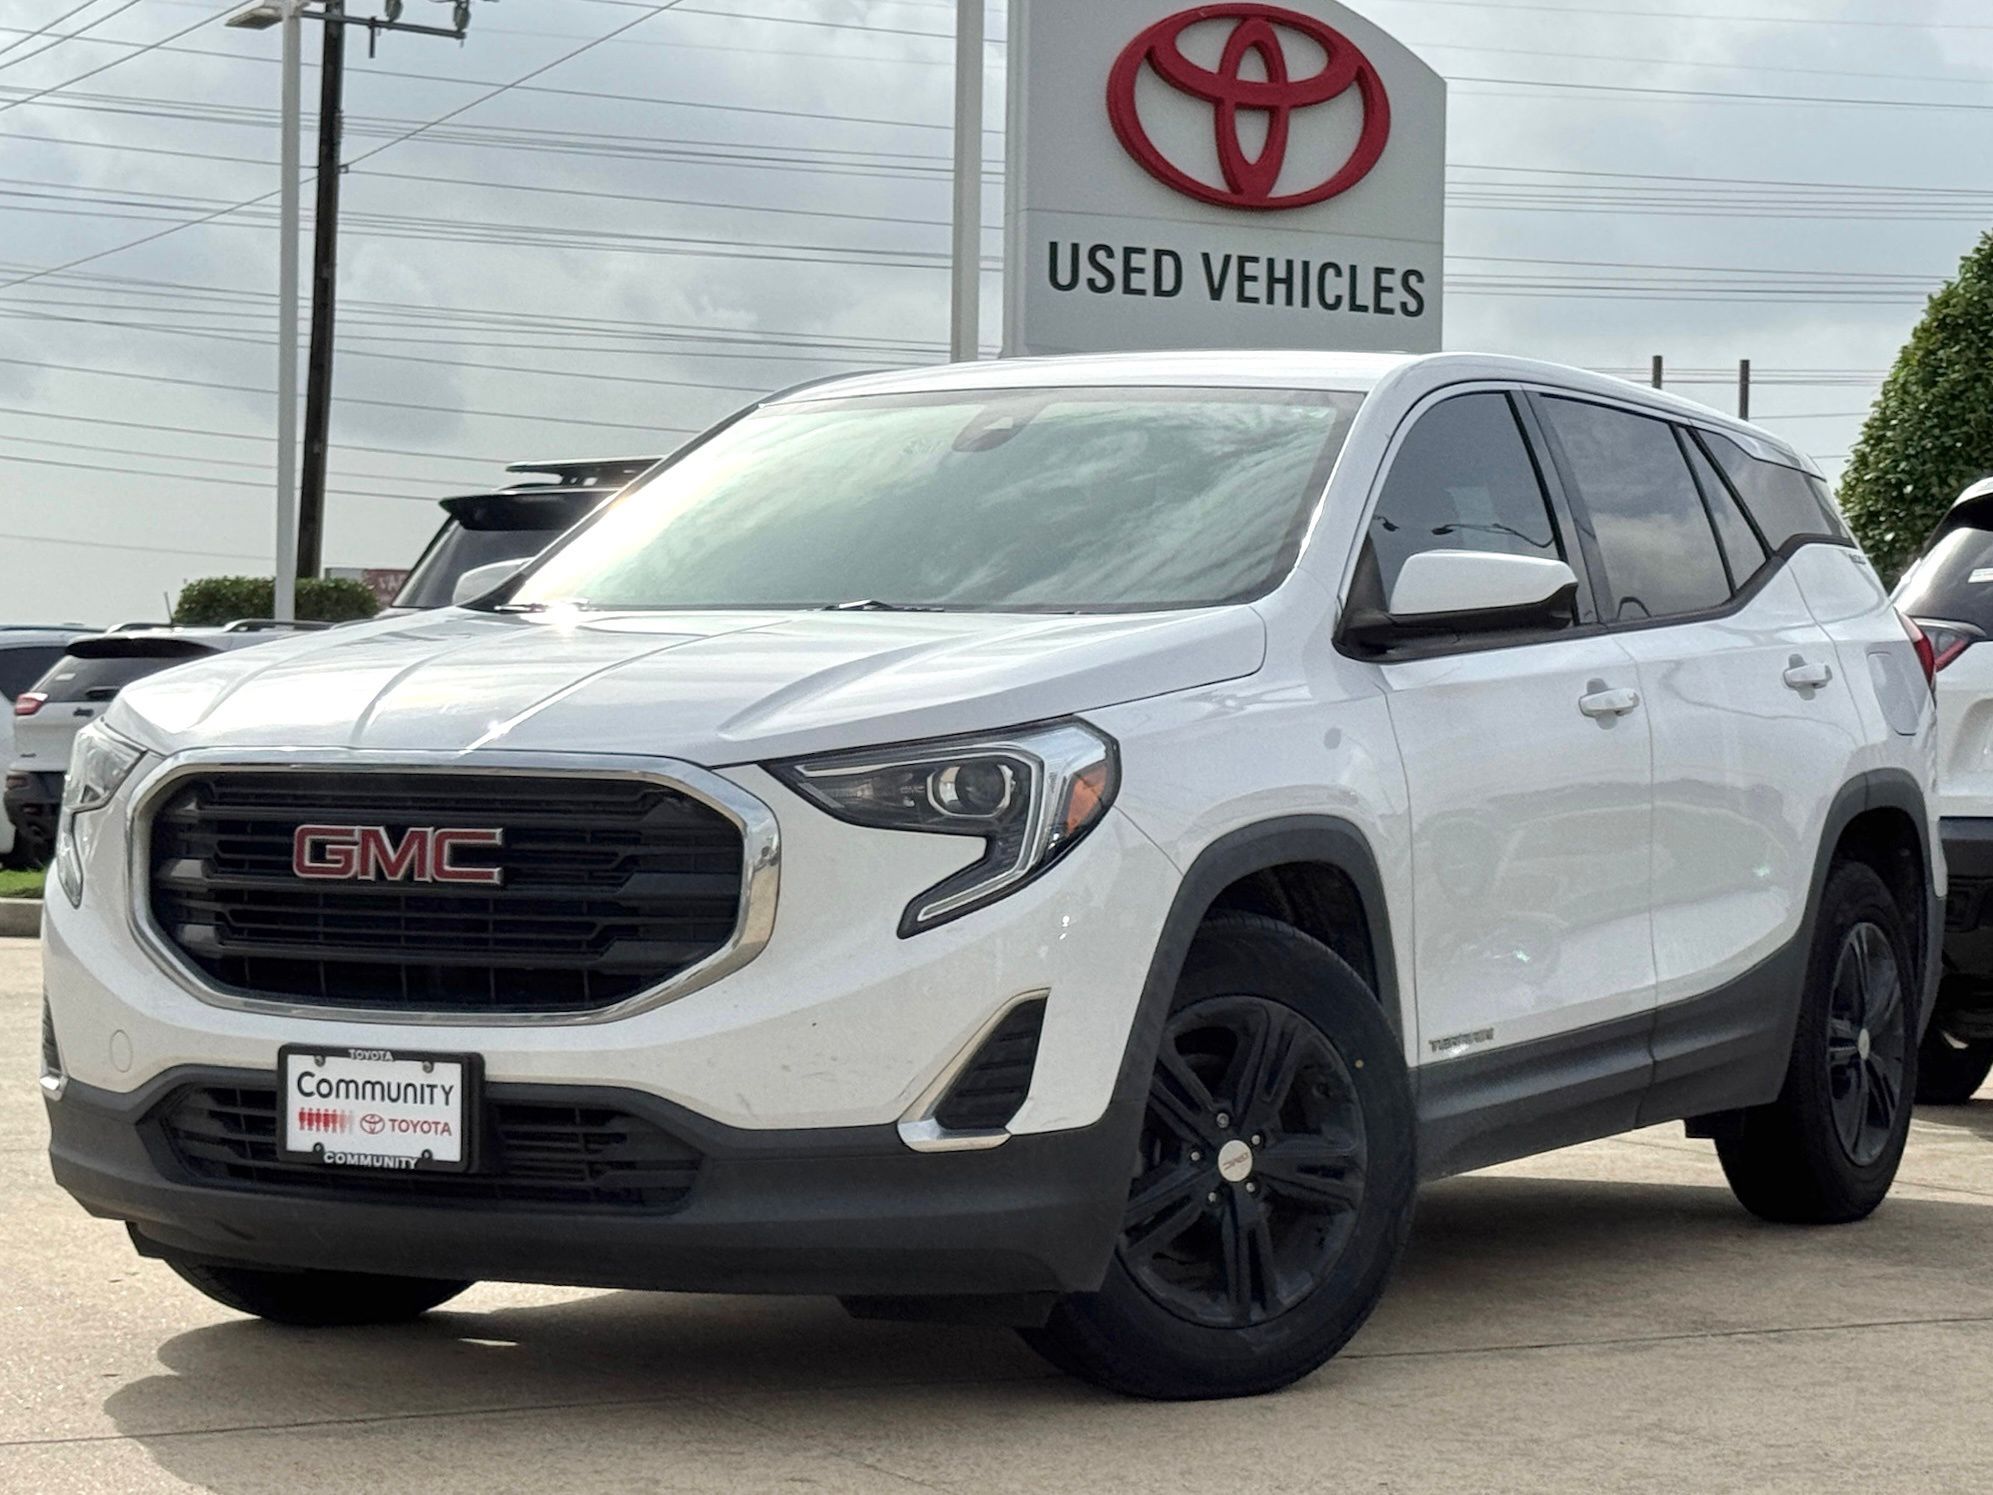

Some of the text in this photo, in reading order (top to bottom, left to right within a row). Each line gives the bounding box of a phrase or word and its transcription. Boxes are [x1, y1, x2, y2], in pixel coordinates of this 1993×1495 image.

[1048, 241, 1425, 318] USED VEHICLES
[293, 824, 503, 884] GMC
[348, 1049, 394, 1062] TOYOTA
[388, 1118, 452, 1136] TOYOTA
[323, 1152, 418, 1169] COMMUNITY
